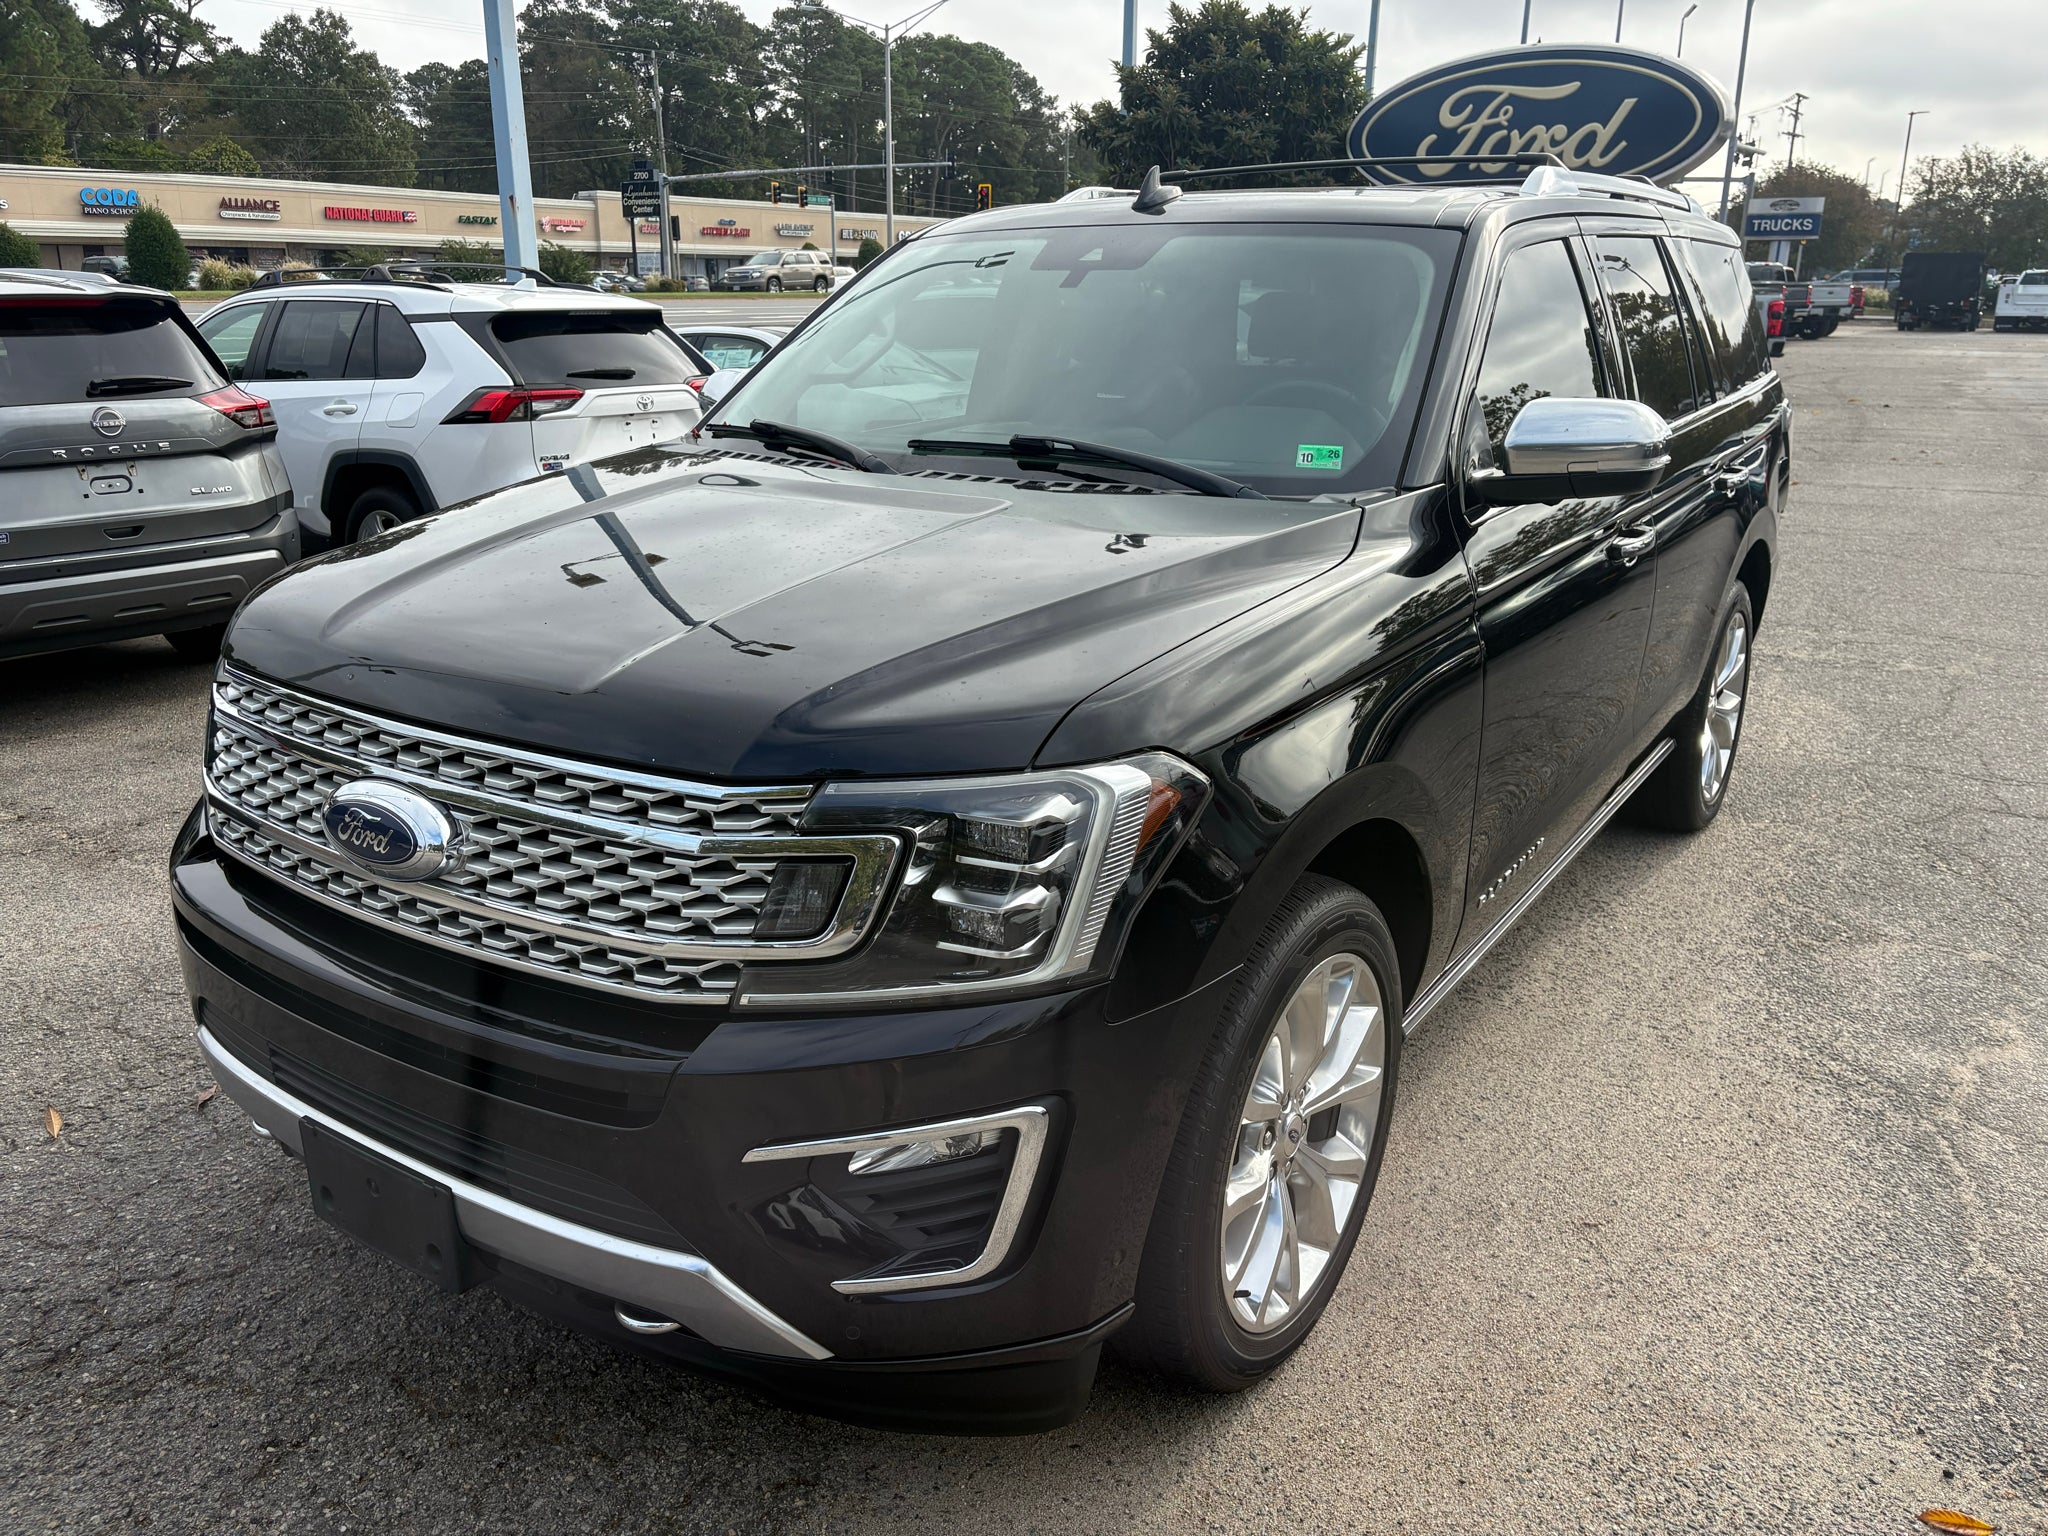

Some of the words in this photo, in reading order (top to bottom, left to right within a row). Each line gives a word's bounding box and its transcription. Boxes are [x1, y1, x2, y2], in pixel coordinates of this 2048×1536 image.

[1416, 80, 1639, 177] Ford
[633, 172, 649, 180] 2700
[80, 187, 139, 207] CODA
[623, 198, 661, 206] Convenienc
[219, 196, 281, 212] ALLIANCE
[632, 205, 654, 213] Center
[325, 206, 372, 221] NATIONAL
[372, 209, 403, 222] GUARD
[1752, 219, 1813, 231] TRUCKS
[52, 442, 170, 458] ROGUE
[1328, 449, 1340, 459] 26
[539, 453, 570, 462] RAV4
[1301, 452, 1314, 463] 10
[211, 485, 233, 493] AWD
[337, 807, 394, 854] Ford
